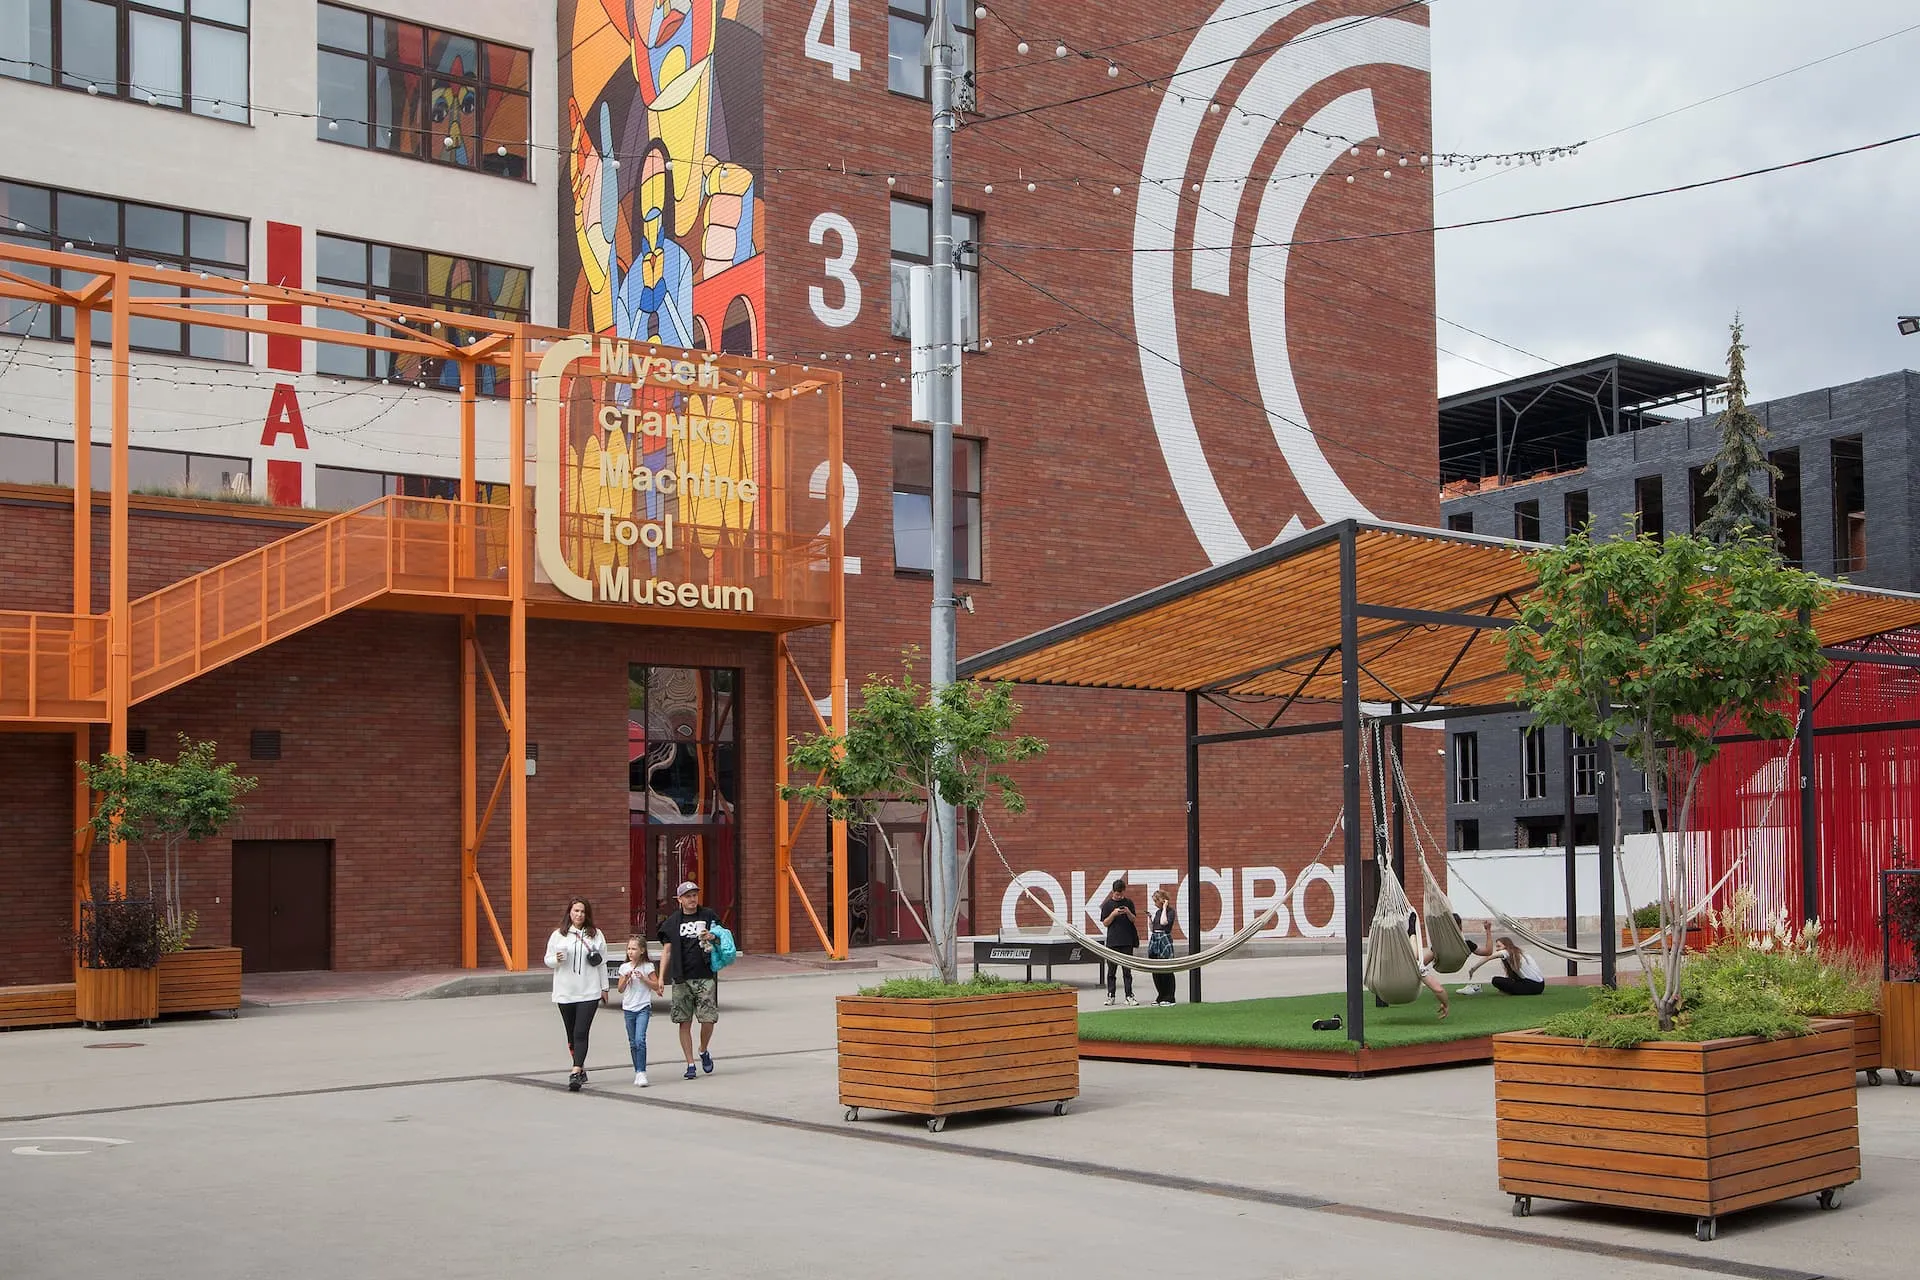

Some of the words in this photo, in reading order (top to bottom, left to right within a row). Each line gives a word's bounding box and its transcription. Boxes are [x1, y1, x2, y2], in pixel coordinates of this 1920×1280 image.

[804, 0, 861, 82] 4
[808, 211, 862, 328] 3
[599, 336, 719, 390] Музей
[598, 405, 732, 446] станка
[599, 451, 759, 503] Machine
[597, 507, 673, 550] Tool
[808, 459, 862, 575] 2
[599, 565, 754, 612] Museum
[991, 949, 1014, 957] START
[1015, 949, 1031, 958] LINE
